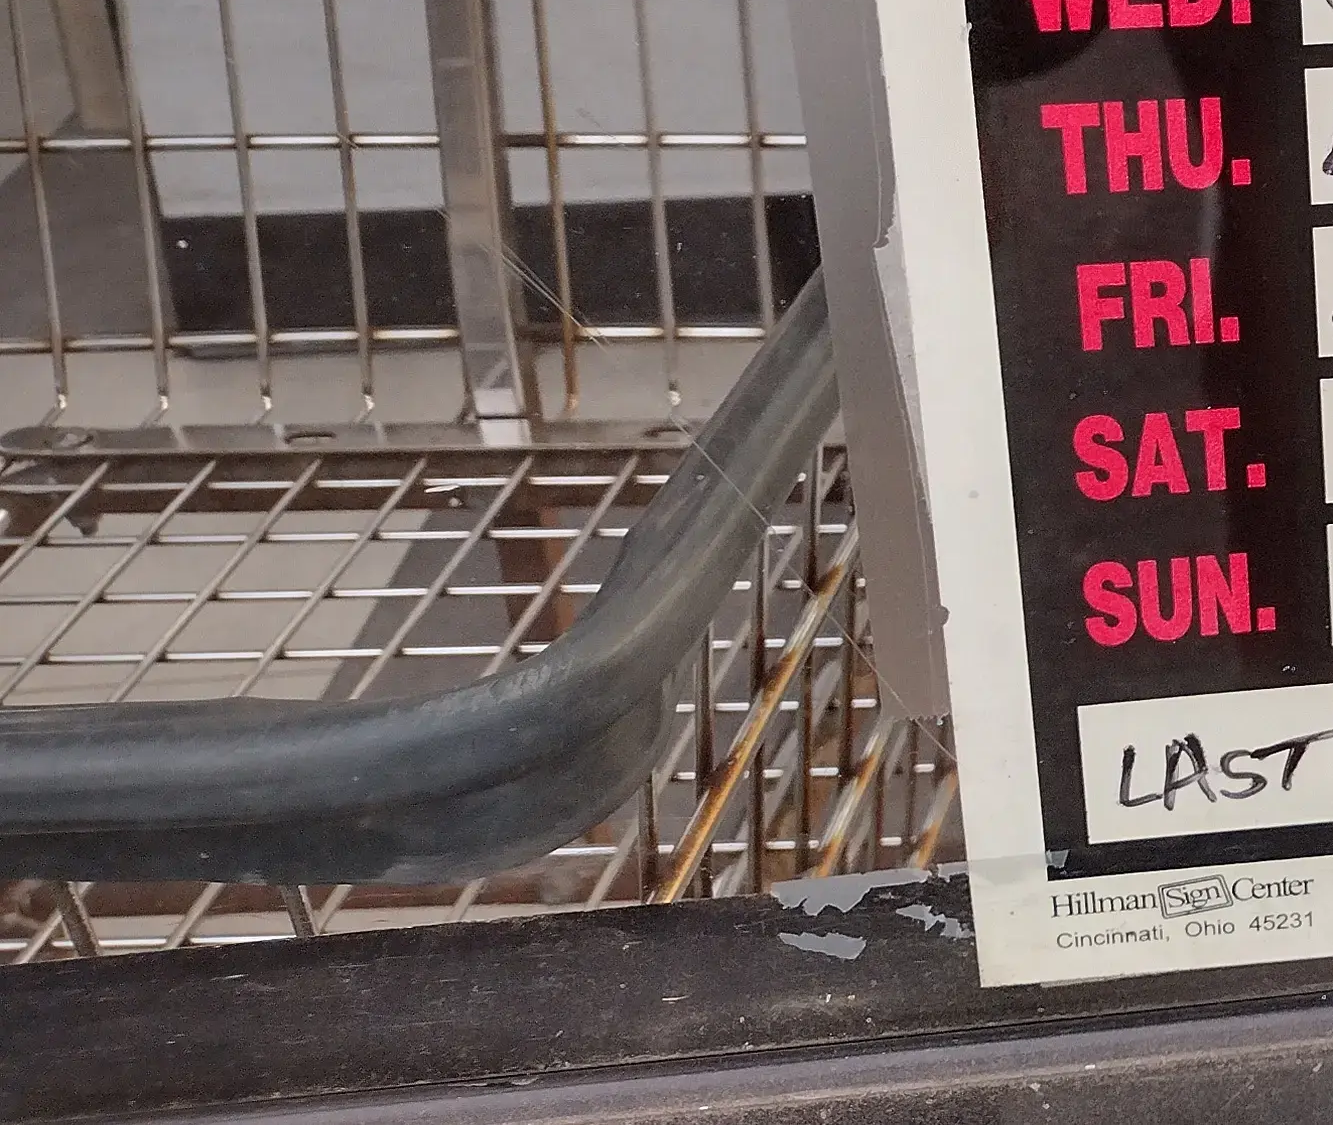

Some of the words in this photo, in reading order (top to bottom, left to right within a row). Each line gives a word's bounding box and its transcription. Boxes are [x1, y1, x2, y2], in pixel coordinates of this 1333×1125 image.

[1040, 96, 1252, 195] THU.
[1076, 257, 1240, 351] FRI.
[1073, 407, 1266, 501] SAT.
[1083, 553, 1276, 646] SUN.
[1051, 890, 1158, 918] Hillman
[1165, 882, 1222, 910] Sign
[1231, 877, 1315, 903] Center
[1056, 924, 1170, 950] Cincinnati,
[1185, 919, 1236, 938] Ohio
[1249, 910, 1314, 932] 45231
